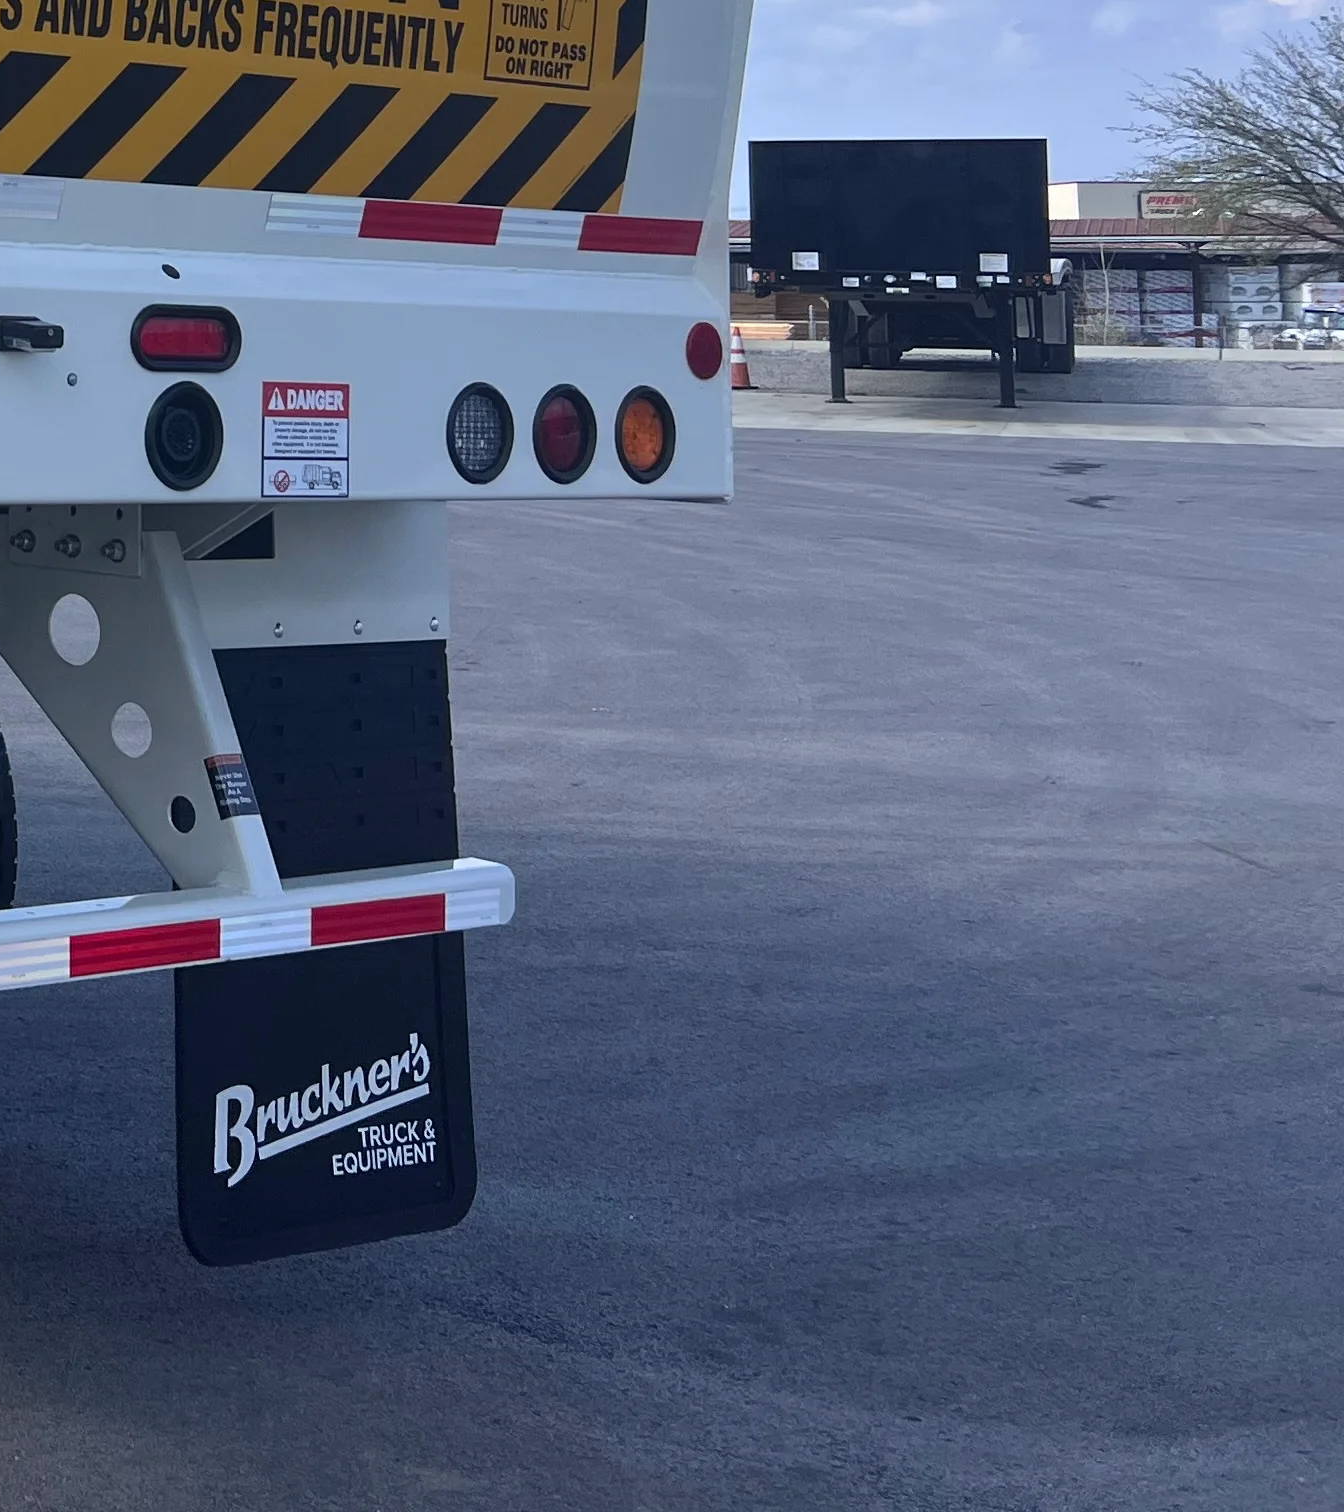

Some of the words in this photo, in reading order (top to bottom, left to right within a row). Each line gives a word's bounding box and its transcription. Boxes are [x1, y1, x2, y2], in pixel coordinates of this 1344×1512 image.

[502, 3, 548, 30] TURNS
[254, 0, 465, 74] FREQUENTLY
[495, 35, 515, 54] DO
[519, 37, 549, 57] NOT
[552, 41, 586, 61] PASS
[506, 57, 525, 75] ON
[530, 59, 573, 80] RIGHT
[287, 389, 344, 411] DANGER
[214, 1032, 431, 1188] Bruckner's
[358, 1120, 420, 1148] TRUCK
[423, 1118, 436, 1138] &
[332, 1141, 437, 1176] EQUIPMENT
